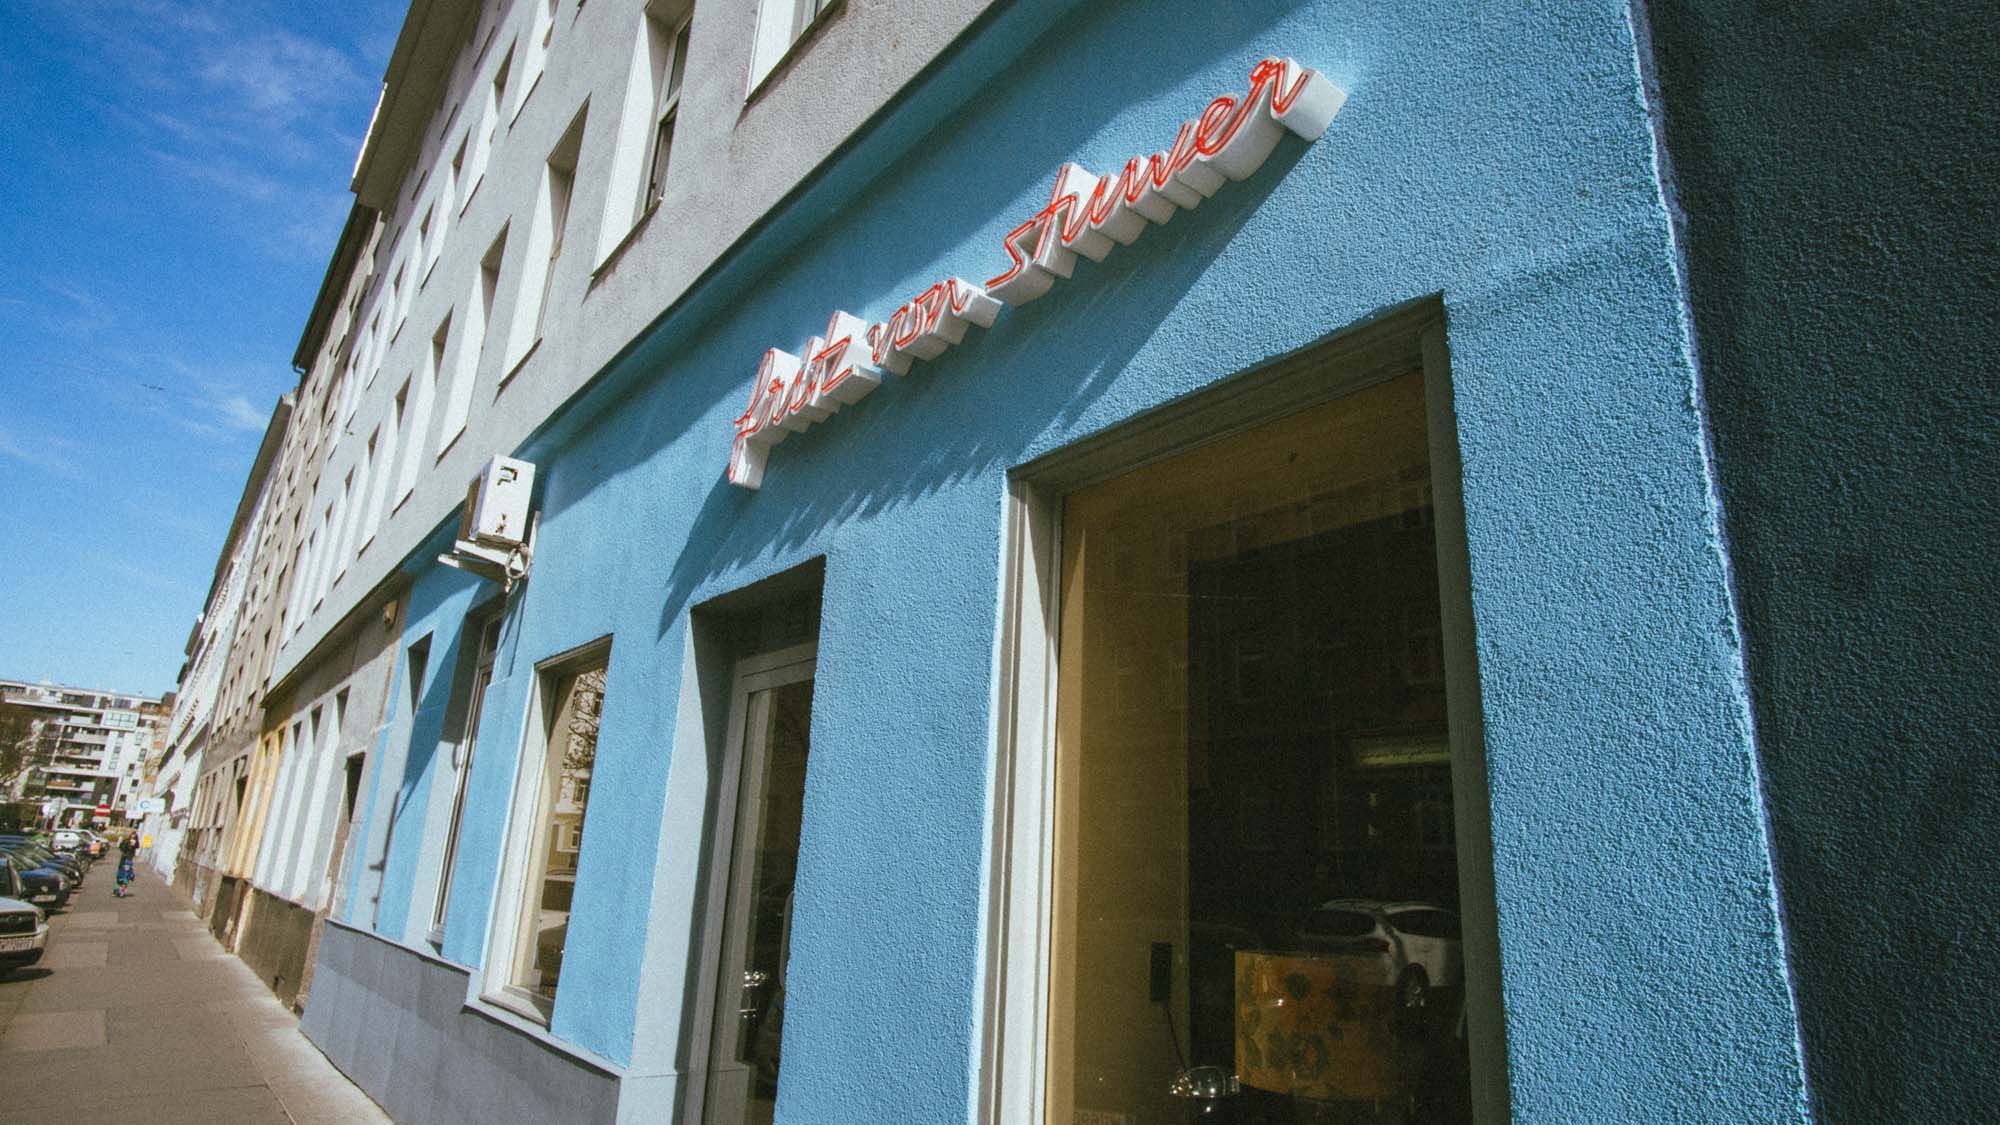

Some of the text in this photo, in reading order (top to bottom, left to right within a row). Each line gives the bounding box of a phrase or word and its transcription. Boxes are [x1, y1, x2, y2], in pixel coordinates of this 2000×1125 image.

[728, 57, 1316, 484] fritz von stuwer
